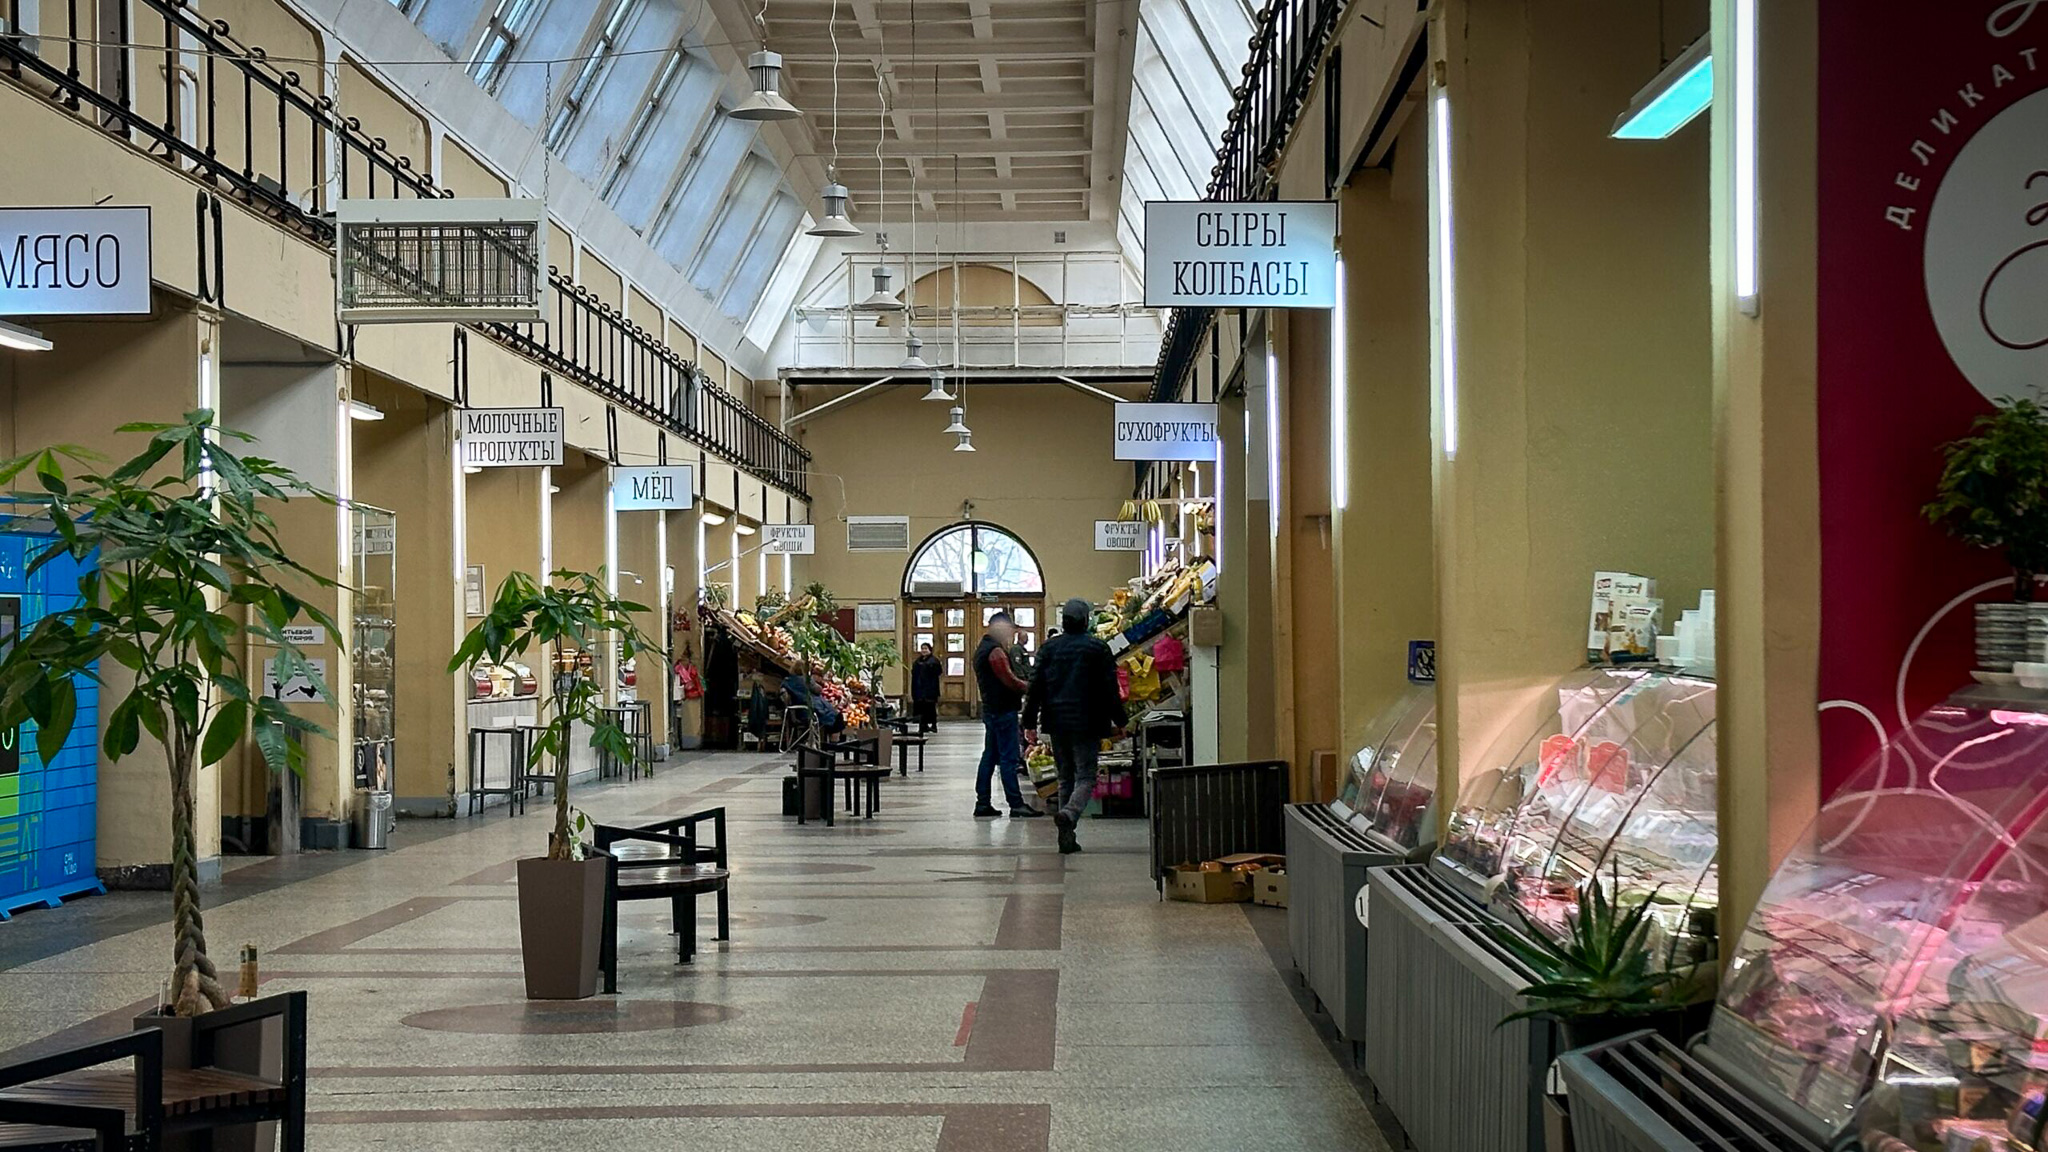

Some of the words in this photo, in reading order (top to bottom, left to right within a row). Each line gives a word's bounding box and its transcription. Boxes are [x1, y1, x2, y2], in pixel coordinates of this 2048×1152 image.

[1197, 212, 1288, 248] СЫРЫ
[0, 233, 120, 289] МЯСО
[1172, 260, 1309, 296] КОЛБАСЫ
[467, 412, 558, 434] МОЛОЧНЫЕ
[1117, 421, 1215, 442] СУХОФРУКТЫ
[468, 440, 555, 463] ПРОДУКТЫ
[632, 471, 674, 502] МЁД
[770, 527, 806, 538] ФРУКТЫ
[1104, 523, 1141, 535] ФРУКТЫ
[1106, 537, 1136, 549] ОВОЩИ
